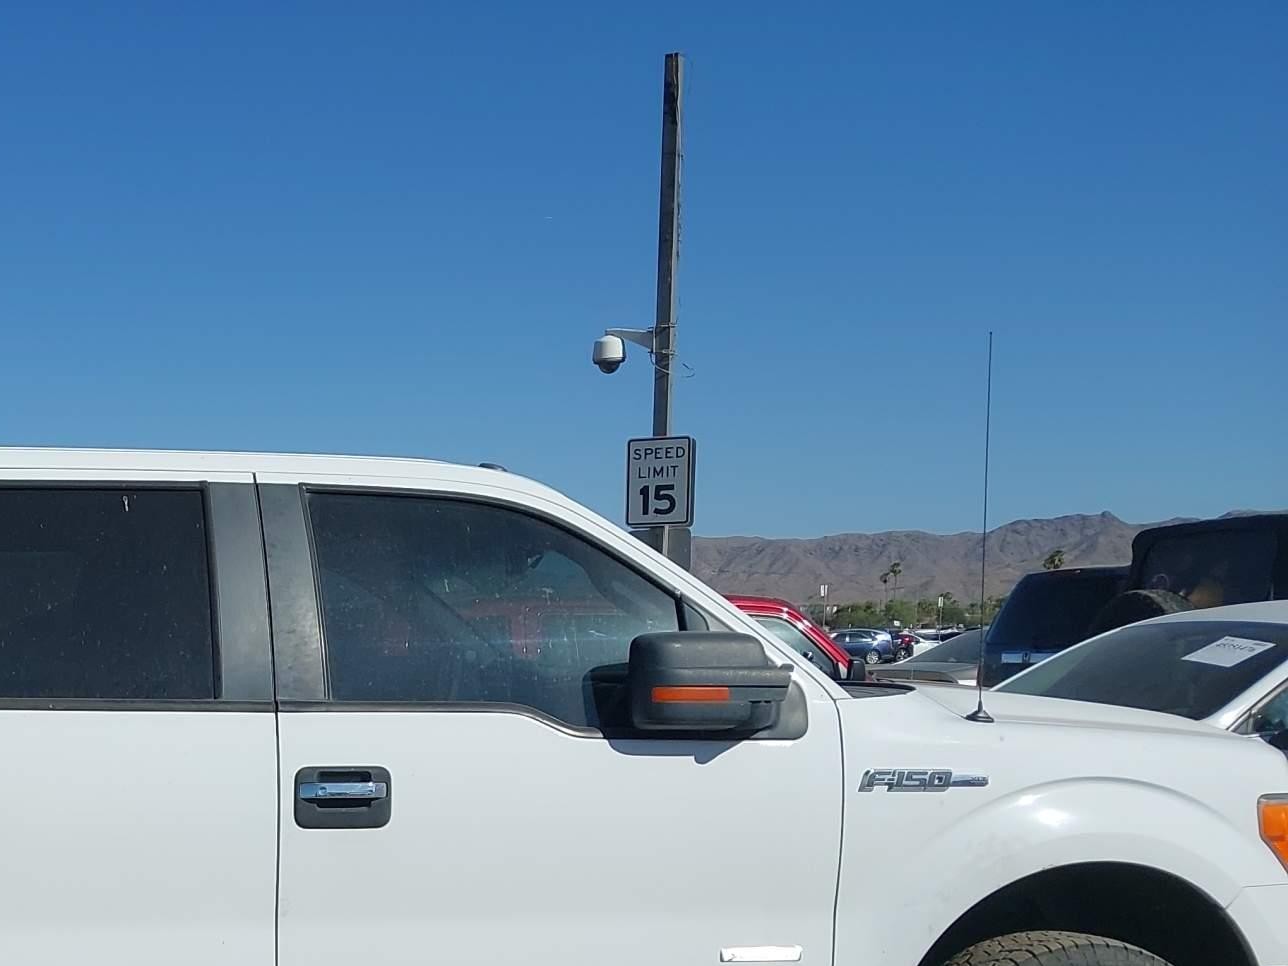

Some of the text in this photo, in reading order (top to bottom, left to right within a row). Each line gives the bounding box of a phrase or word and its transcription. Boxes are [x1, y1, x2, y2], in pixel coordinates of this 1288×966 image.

[632, 446, 686, 461] SPEED
[637, 464, 679, 479] LIMIT
[639, 483, 677, 516] 15
[857, 767, 953, 793] F-150
